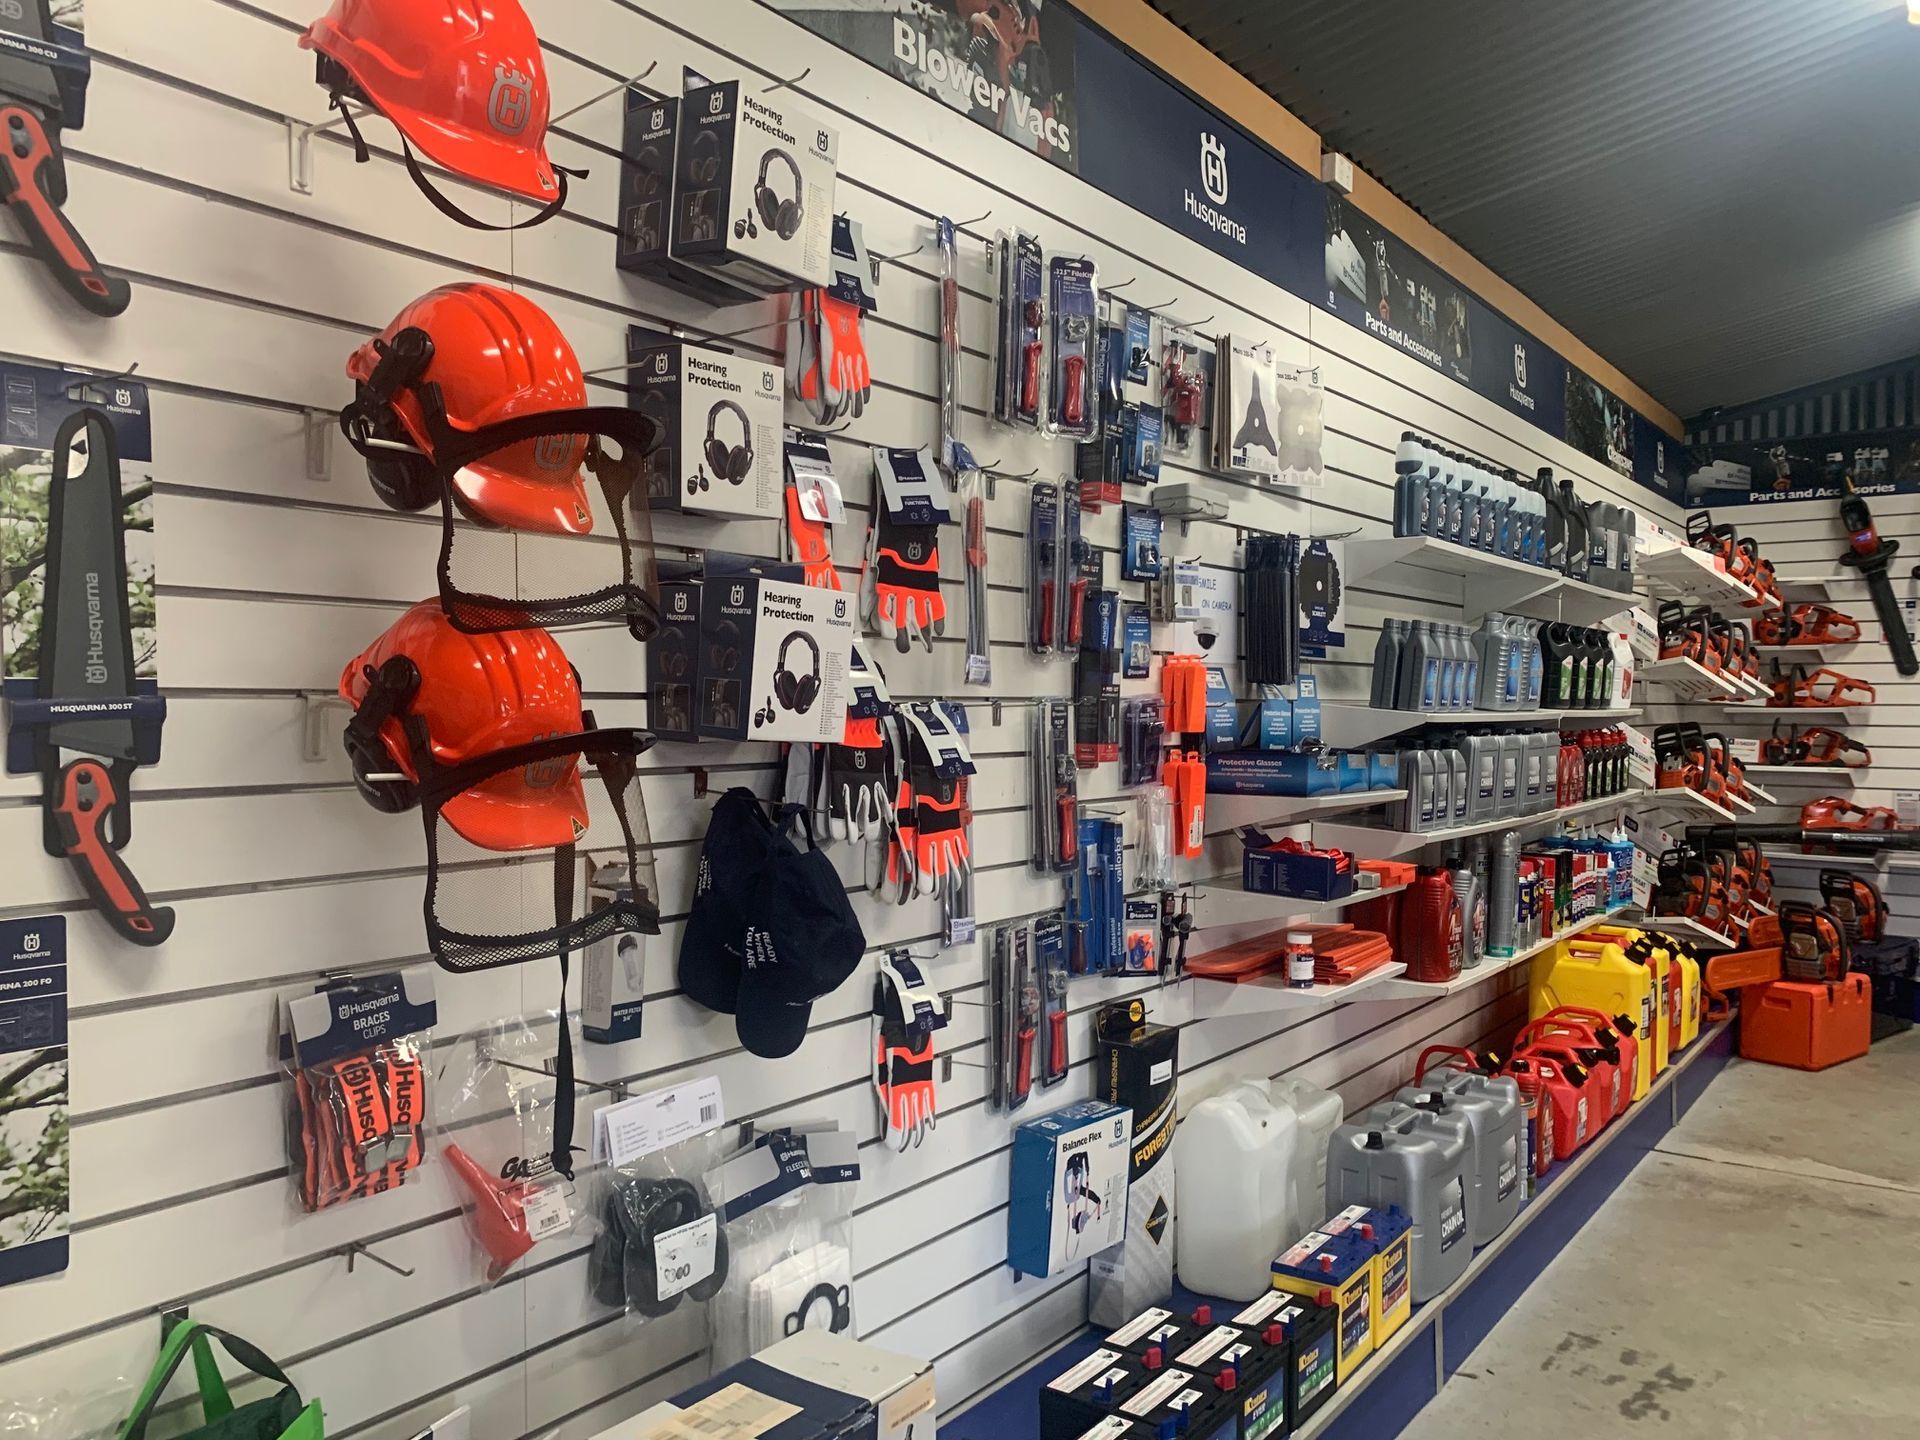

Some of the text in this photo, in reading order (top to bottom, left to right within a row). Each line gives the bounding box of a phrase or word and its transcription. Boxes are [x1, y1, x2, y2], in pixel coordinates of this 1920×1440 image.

[893, 17, 1070, 152] Blower Vacs
[700, 112, 731, 125] Husqvarna
[744, 95, 783, 126] Hearing
[642, 127, 671, 142] Husqvarna
[743, 112, 796, 146] Protection
[1184, 188, 1247, 245] Husqvarna
[1365, 311, 1443, 367] Parts and Accessories
[688, 356, 728, 378] Hearing
[647, 374, 677, 384] Husqvarna
[687, 373, 742, 393] Protection
[754, 389, 782, 402] Husqvarna
[1509, 383, 1535, 411] Husqvarna
[106, 404, 142, 416] Husqvarna
[1750, 483, 1896, 502] Parts and Accsories
[764, 591, 802, 608] Hearing
[1202, 600, 1233, 611] ON CAMERA
[87, 573, 104, 664] Husqvarna
[667, 613, 695, 622] Husqvarna
[721, 607, 751, 615] Husqvarna
[763, 606, 814, 623] Protection
[826, 617, 852, 627] Husqvarna
[51, 704, 107, 713] HUSQVARNA
[746, 926, 757, 969] YOU ARE
[754, 932, 766, 963] WHEN
[762, 931, 779, 963] READY
[13, 951, 51, 961] Husqvarna
[23, 979, 39, 988] 200
[40, 978, 52, 986] FO
[350, 993, 400, 1015] Husqvarna
[613, 1007, 628, 1017] WATER
[353, 1010, 390, 1031] BRACES
[363, 1025, 387, 1040] CLIPS
[1062, 1131, 1102, 1153] Balance Flex
[840, 1169, 845, 1177] 5
